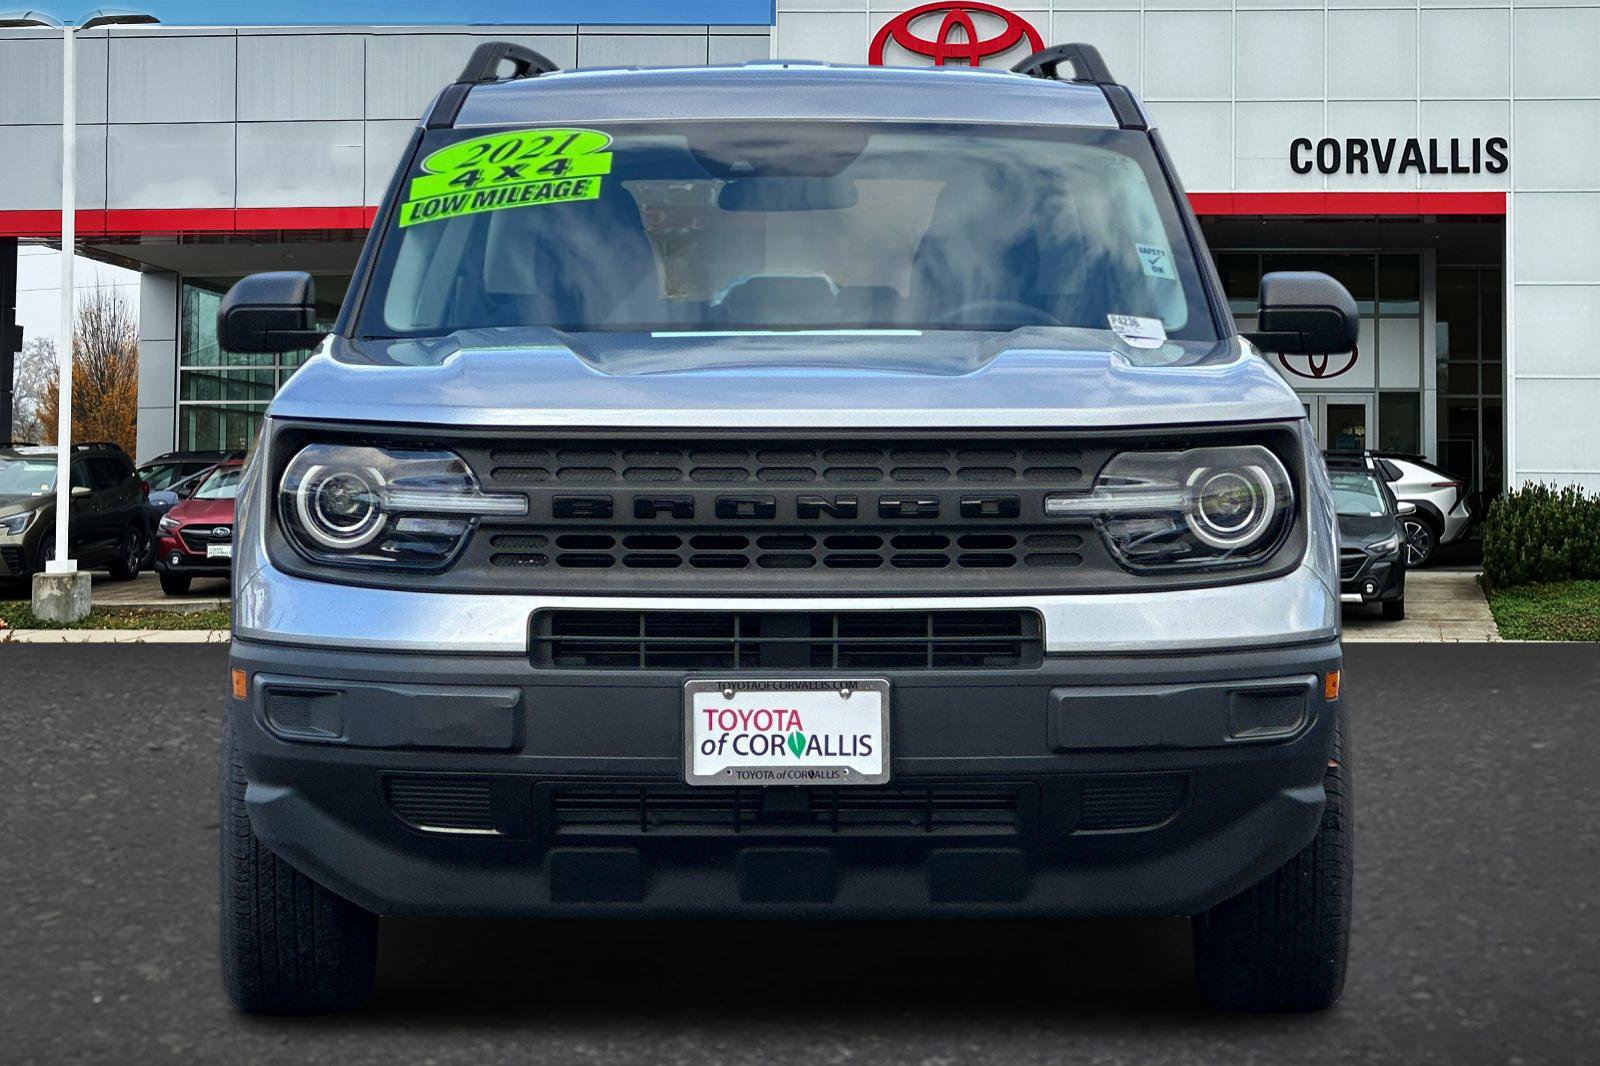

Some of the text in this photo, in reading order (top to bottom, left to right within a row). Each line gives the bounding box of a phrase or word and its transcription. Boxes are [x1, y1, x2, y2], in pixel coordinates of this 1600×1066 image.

[455, 132, 582, 169] 2021
[1290, 138, 1508, 174] CORVALLIS
[409, 179, 593, 222] LOW MILEAGE
[552, 494, 1021, 519] BRONCO
[717, 680, 858, 691] TOYOTAOFCORVALLIS.COM
[703, 709, 803, 732] TOYOTA
[701, 732, 729, 756] of
[736, 770, 775, 779] TOYOTA
[776, 770, 786, 779] of
